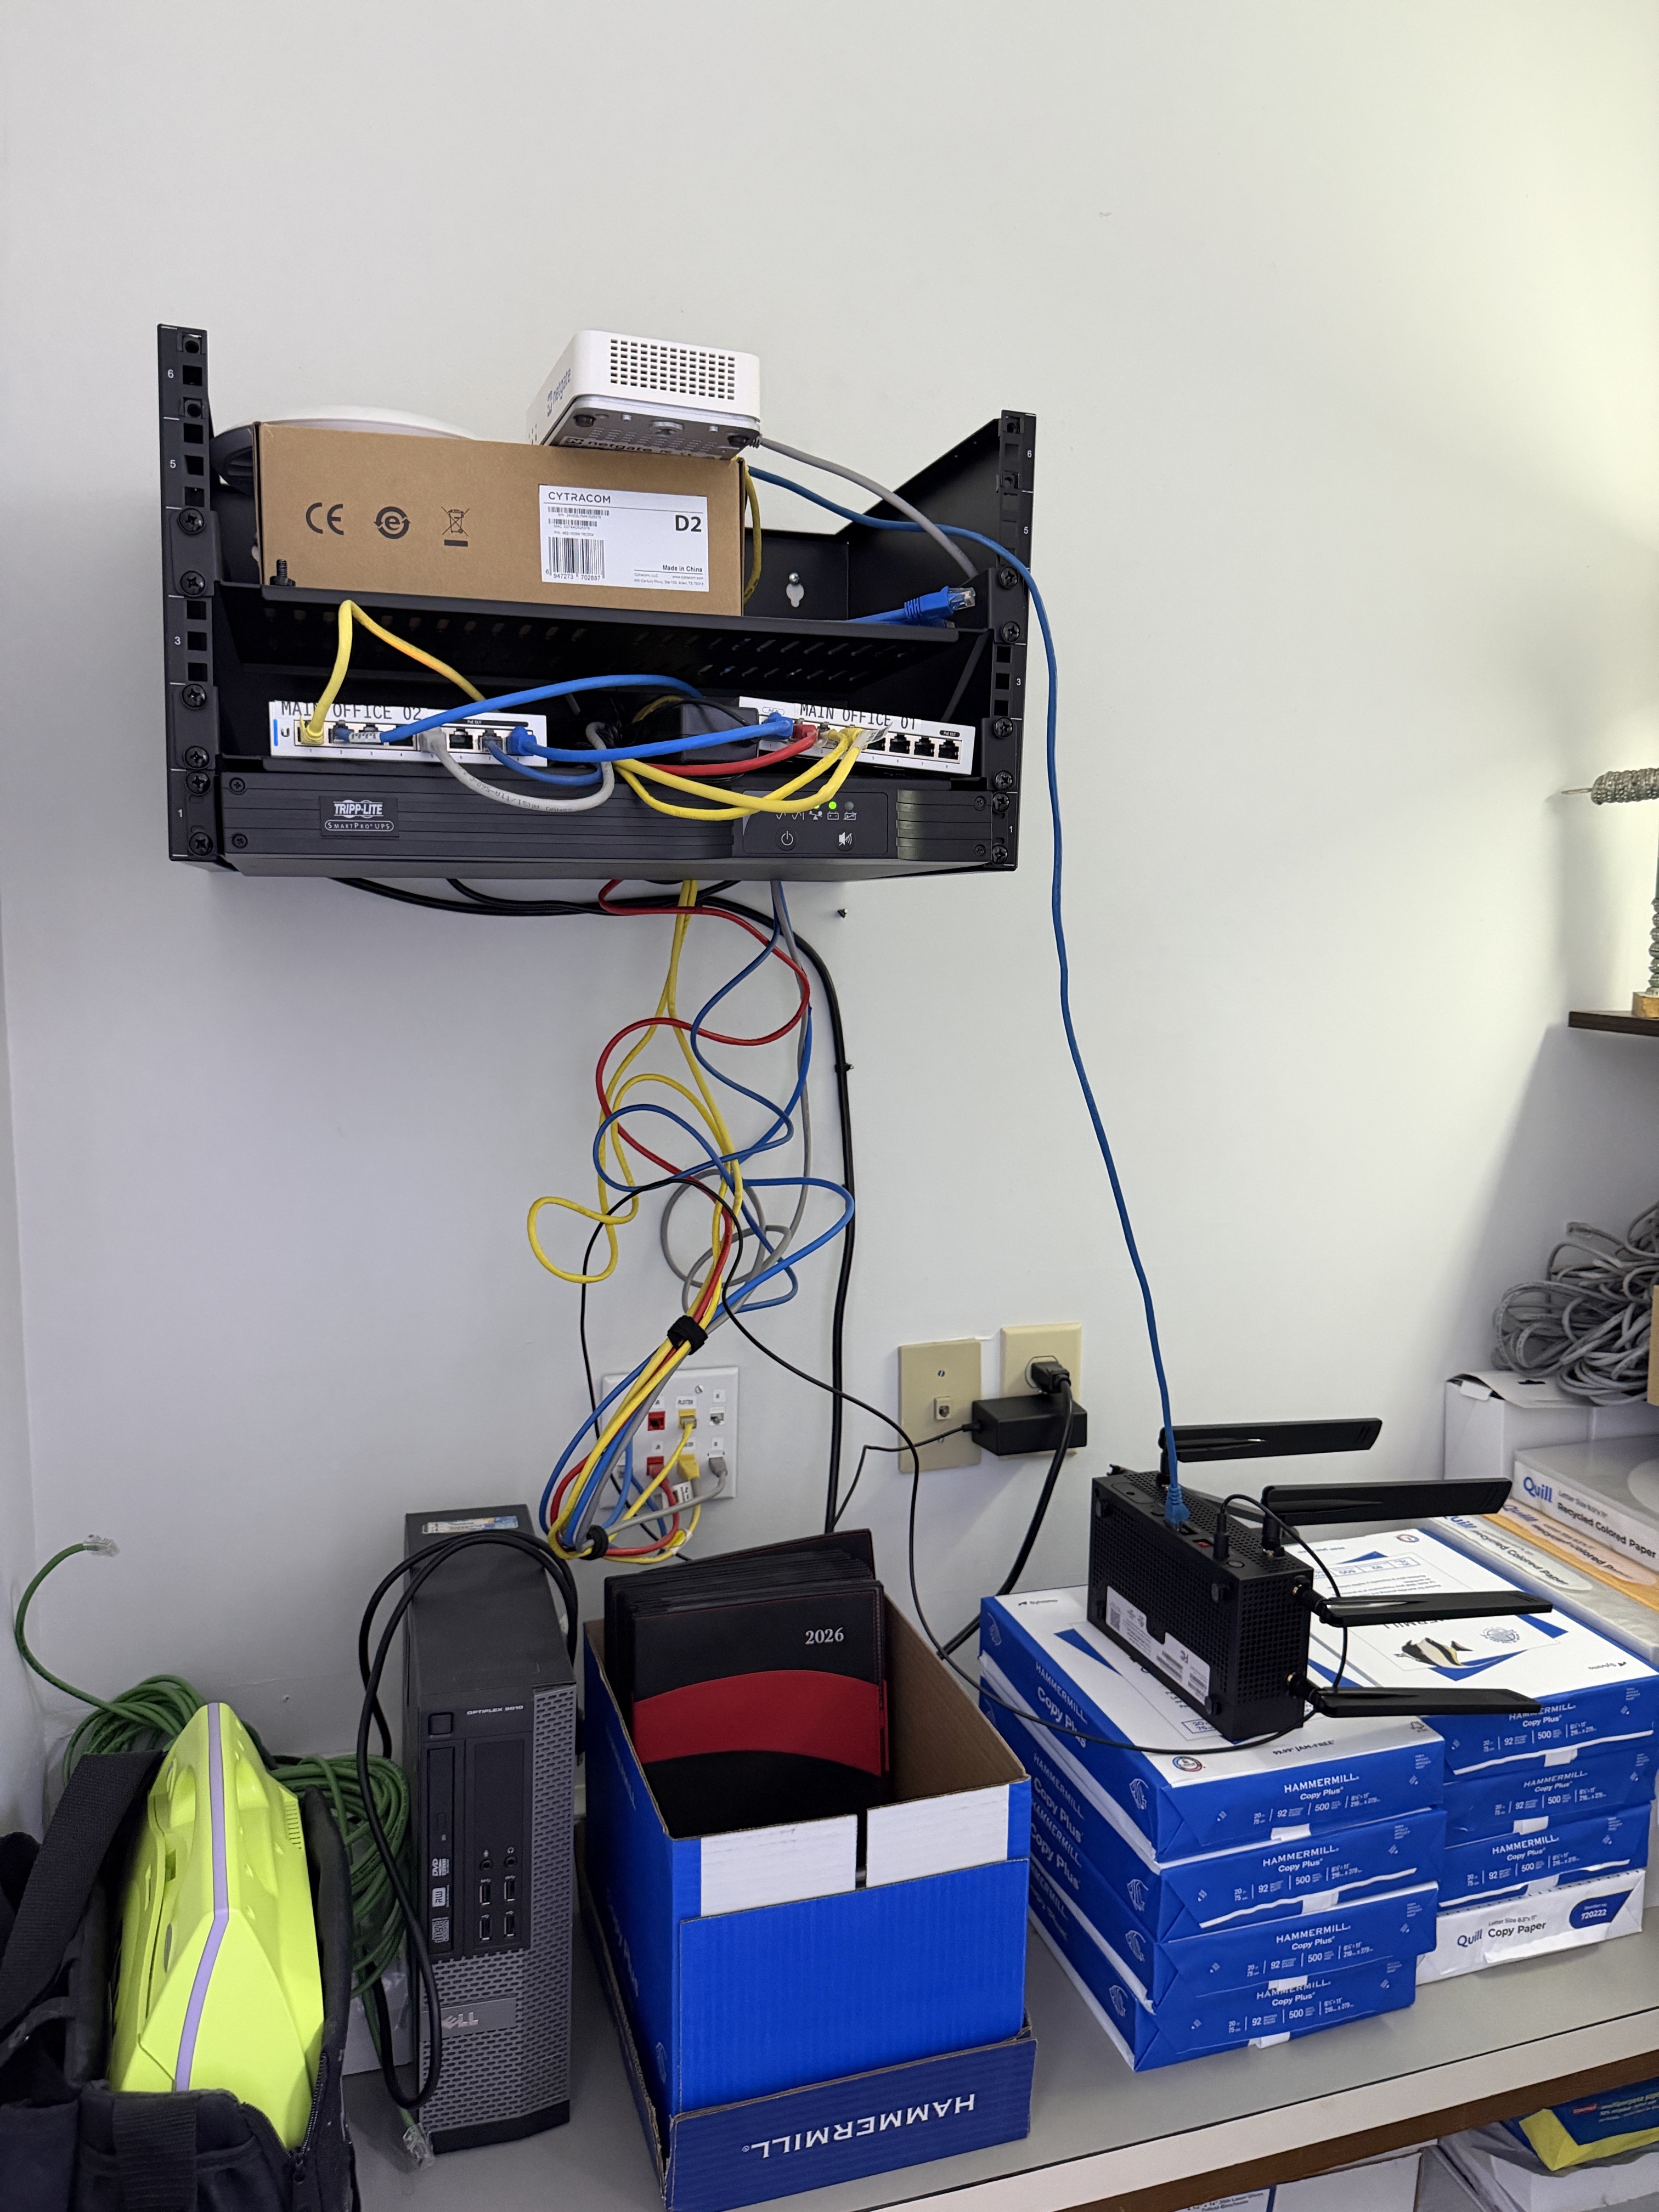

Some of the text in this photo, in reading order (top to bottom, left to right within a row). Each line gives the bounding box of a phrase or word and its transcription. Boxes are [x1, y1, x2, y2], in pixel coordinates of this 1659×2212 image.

[167, 369, 174, 379] 6
[553, 368, 571, 405] netgate
[1026, 450, 1032, 458] 6
[170, 460, 176, 469] 5
[548, 491, 611, 504] CYTRACOM
[675, 515, 702, 533] D2
[1023, 526, 1029, 534] 5
[174, 636, 181, 646] 3
[1017, 677, 1022, 686] 3
[281, 701, 317, 716] MAI
[333, 703, 392, 720] OFFICE
[800, 704, 834, 720] MAIN
[842, 709, 891, 727] OFFICE
[1522, 1476, 1553, 1503] Quill
[1502, 1504, 1538, 1522] Quill
[1443, 1516, 1477, 1530] uill
[1558, 1502, 1594, 1527] Recycled
[1595, 1521, 1627, 1545] Colored
[1629, 1539, 1656, 1559] Paper
[804, 1627, 845, 1645] 2026
[1035, 1662, 1088, 1724] HAMMERMILL
[1037, 1686, 1064, 1725] Copy
[1522, 1719, 1542, 1728] Copy
[1504, 1730, 1551, 1746] 92 500
[1034, 1752, 1085, 1819] HAMMERMILL
[1284, 1773, 1358, 1793] HAMMERMILL
[1523, 1771, 1587, 1788] HAMMERMILL
[1034, 1777, 1060, 1816] Copy
[1300, 1792, 1321, 1801] Copy
[1515, 1801, 1524, 1810] 92
[1548, 1795, 1561, 1804] 500
[1277, 1809, 1287, 1818] 92
[1314, 1802, 1330, 1812] 500
[1492, 1835, 1558, 1855] HAMMERMILL
[1262, 1845, 1338, 1867] HAMMERMILL
[1506, 1852, 1526, 1861] Copy
[1278, 1864, 1300, 1872] Copy
[1488, 1871, 1498, 1880] 92
[1521, 1863, 1534, 1872] 500
[1258, 1884, 1268, 1893] 92
[1295, 1875, 1311, 1885] 500
[1581, 1909, 1607, 1920] 720222
[1276, 1923, 1350, 1944] HAMMERMILL
[1457, 1928, 1483, 1948] Quill
[1488, 1922, 1547, 1938] Copy Paper
[1291, 1942, 1313, 1950] Copy
[1271, 1960, 1280, 1970] 92
[1307, 1953, 1323, 1963] 500
[1272, 1998, 1293, 2006] Copy
[441, 2012, 479, 2029] ELL
[1251, 2017, 1261, 2027] 92
[1289, 2009, 1304, 2019] 500
